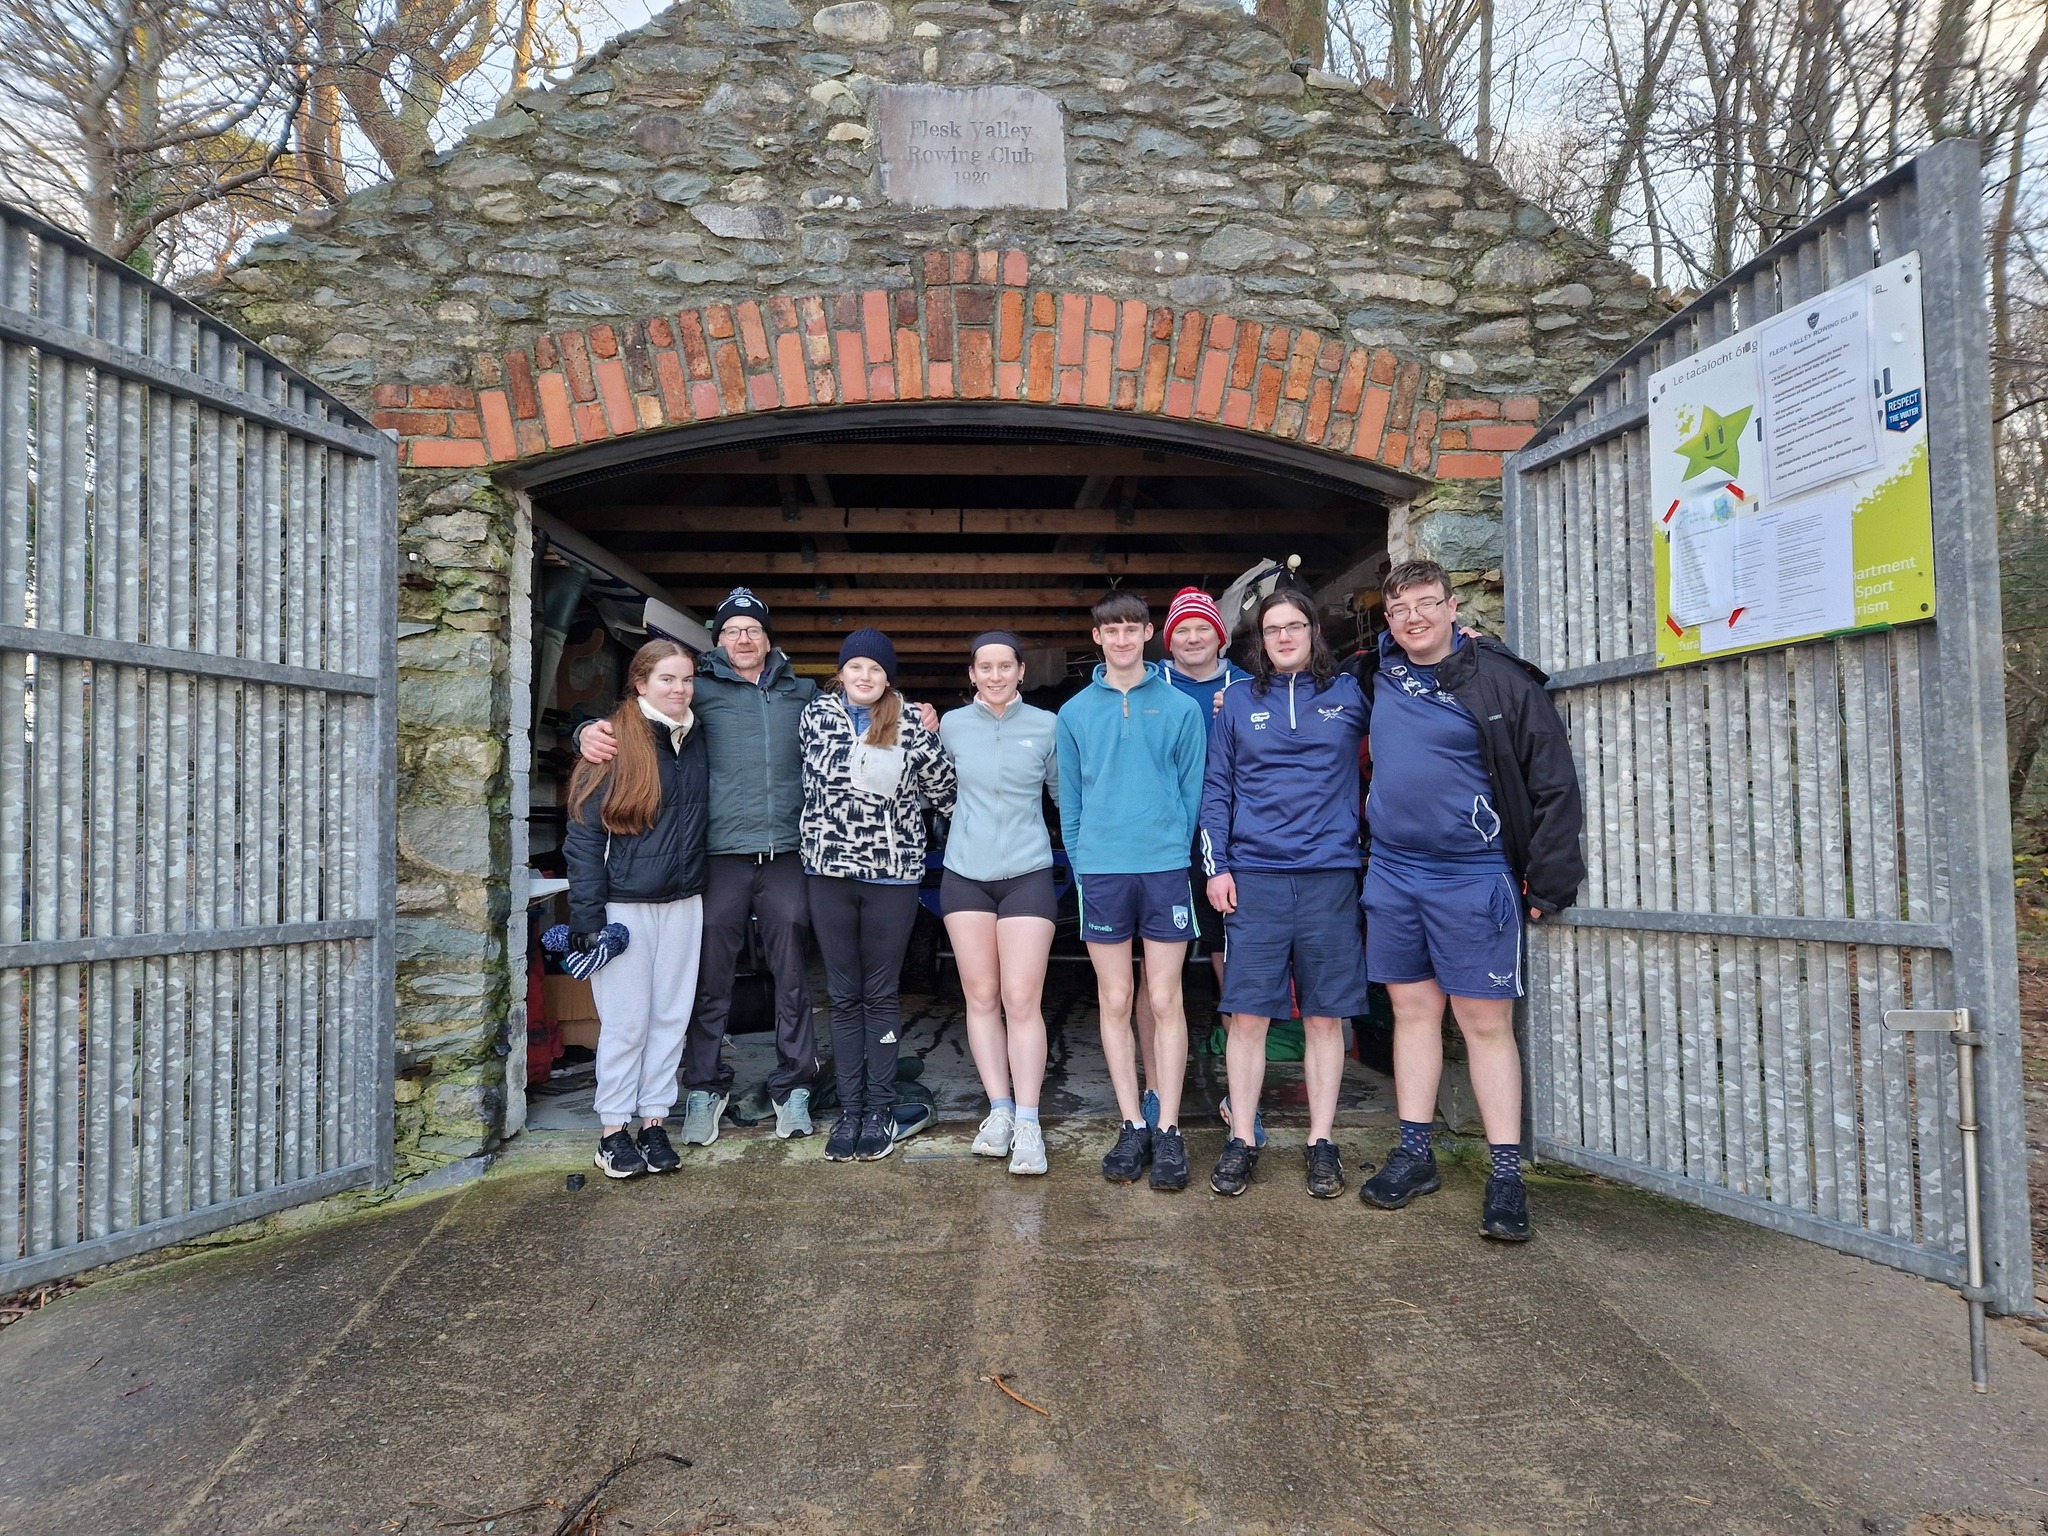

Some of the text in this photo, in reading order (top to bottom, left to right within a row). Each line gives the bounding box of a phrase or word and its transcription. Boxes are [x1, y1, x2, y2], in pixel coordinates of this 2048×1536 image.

[910, 120, 1032, 142] Flesk Valley
[907, 146, 1035, 165] Rowing Club
[953, 171, 990, 185] 1920
[1769, 312, 1859, 357] FLESK VALLEY ROWING CLUB
[1673, 376, 1684, 386] Le
[1686, 352, 1733, 380] tacaíocht
[1888, 393, 1918, 412] RESPECT
[1889, 414, 1900, 424] THE
[1900, 407, 1919, 419] WATER
[1855, 580, 1894, 599] Sport
